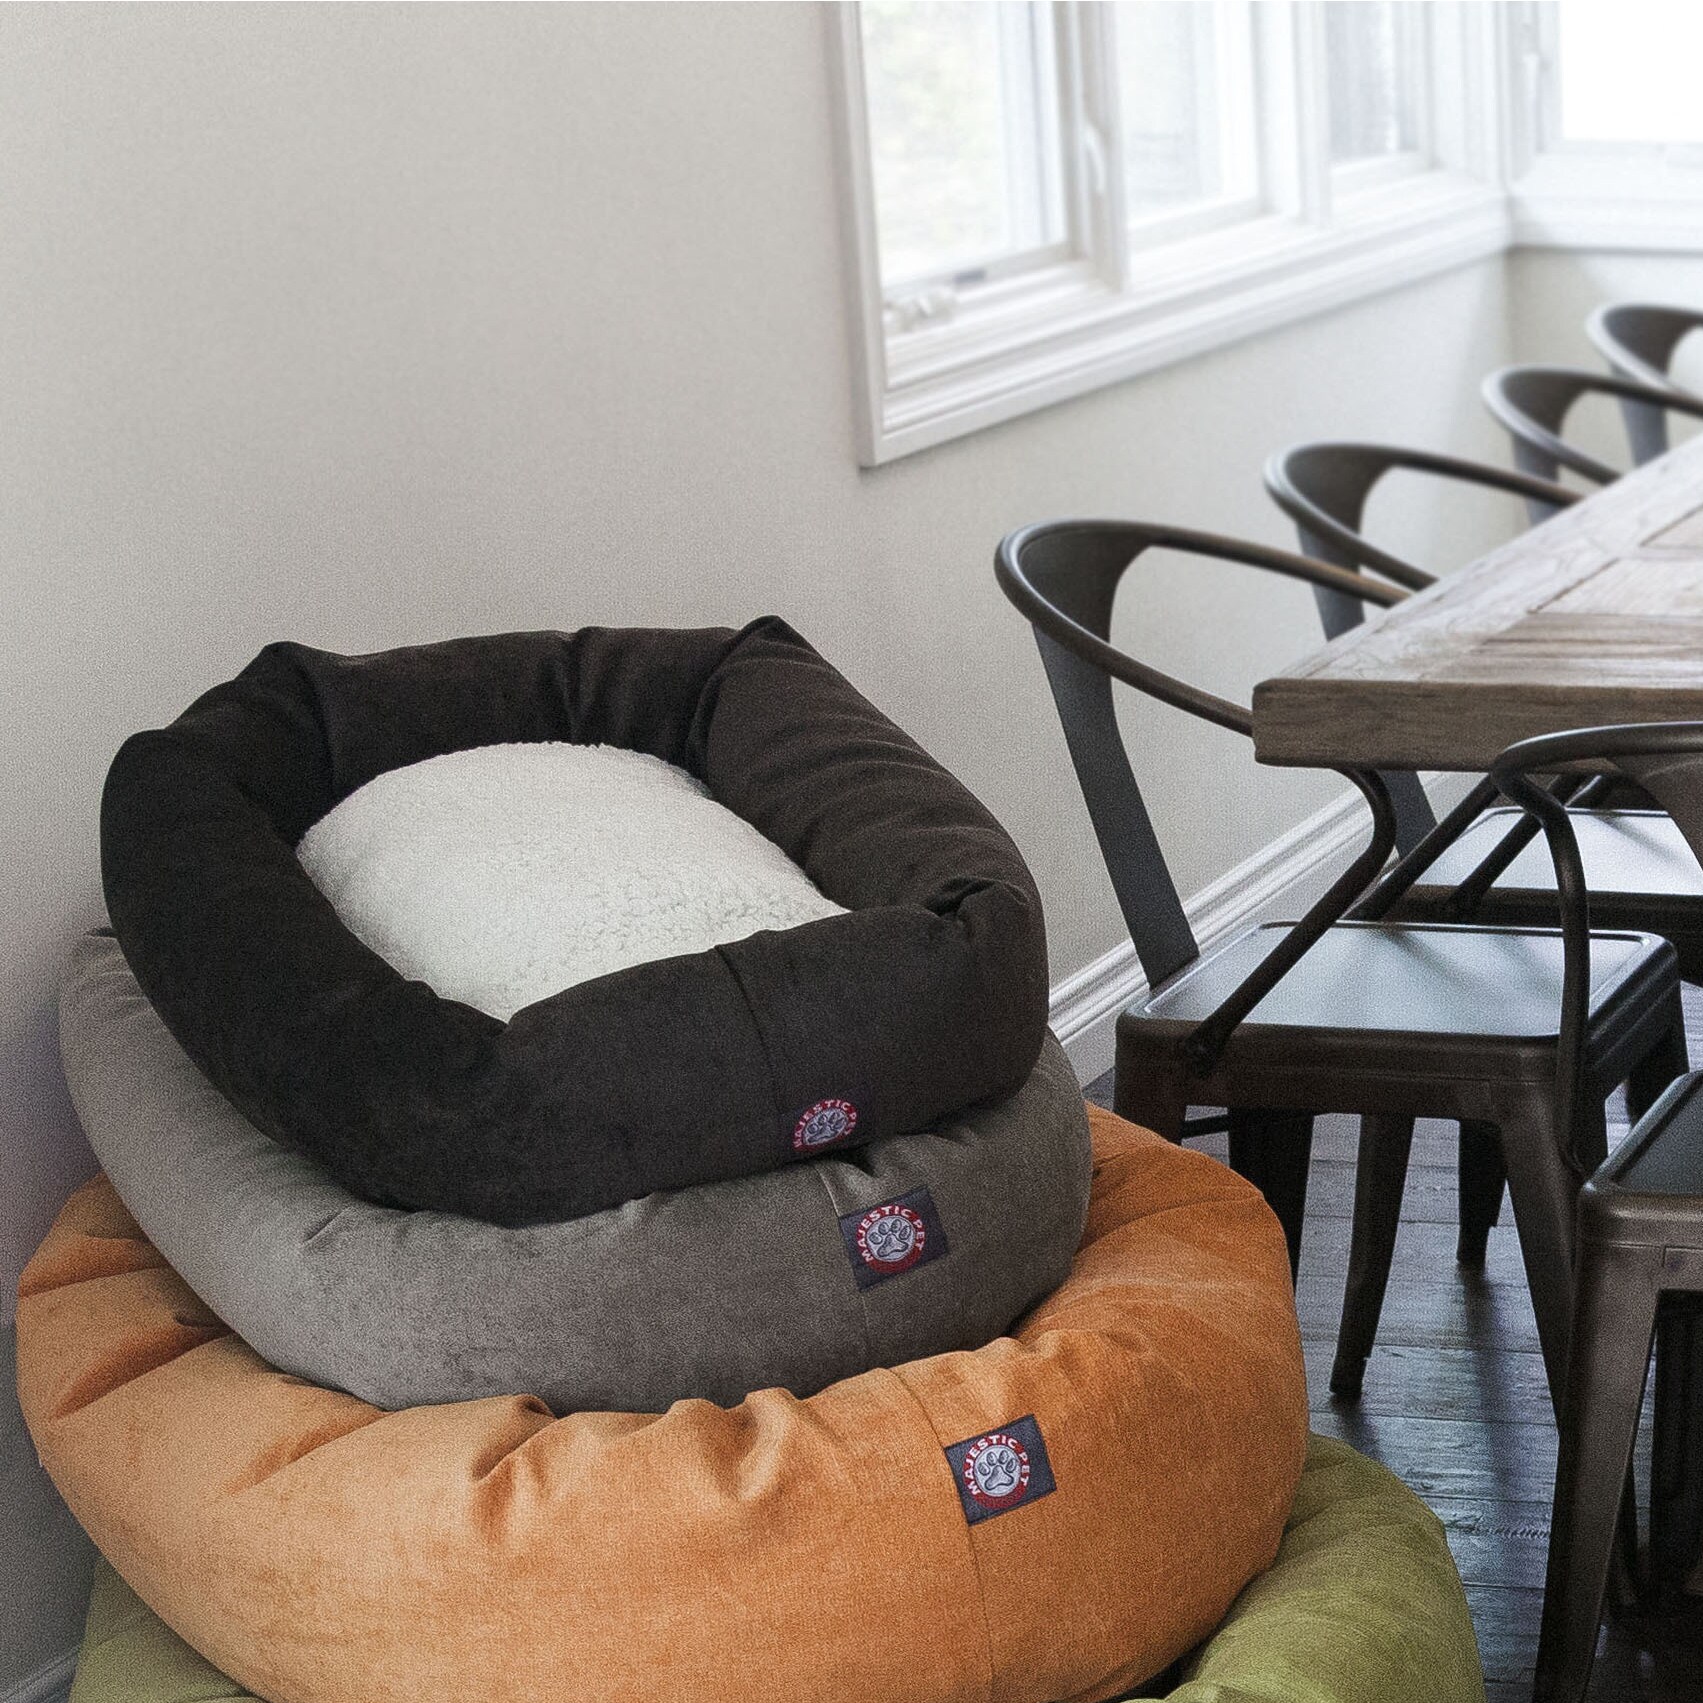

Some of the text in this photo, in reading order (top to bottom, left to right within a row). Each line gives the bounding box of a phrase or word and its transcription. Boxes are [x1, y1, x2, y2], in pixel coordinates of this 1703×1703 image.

[858, 1205, 925, 1262] MAJESTIC PET
[964, 1435, 1030, 1495] MAJESTIC PET
